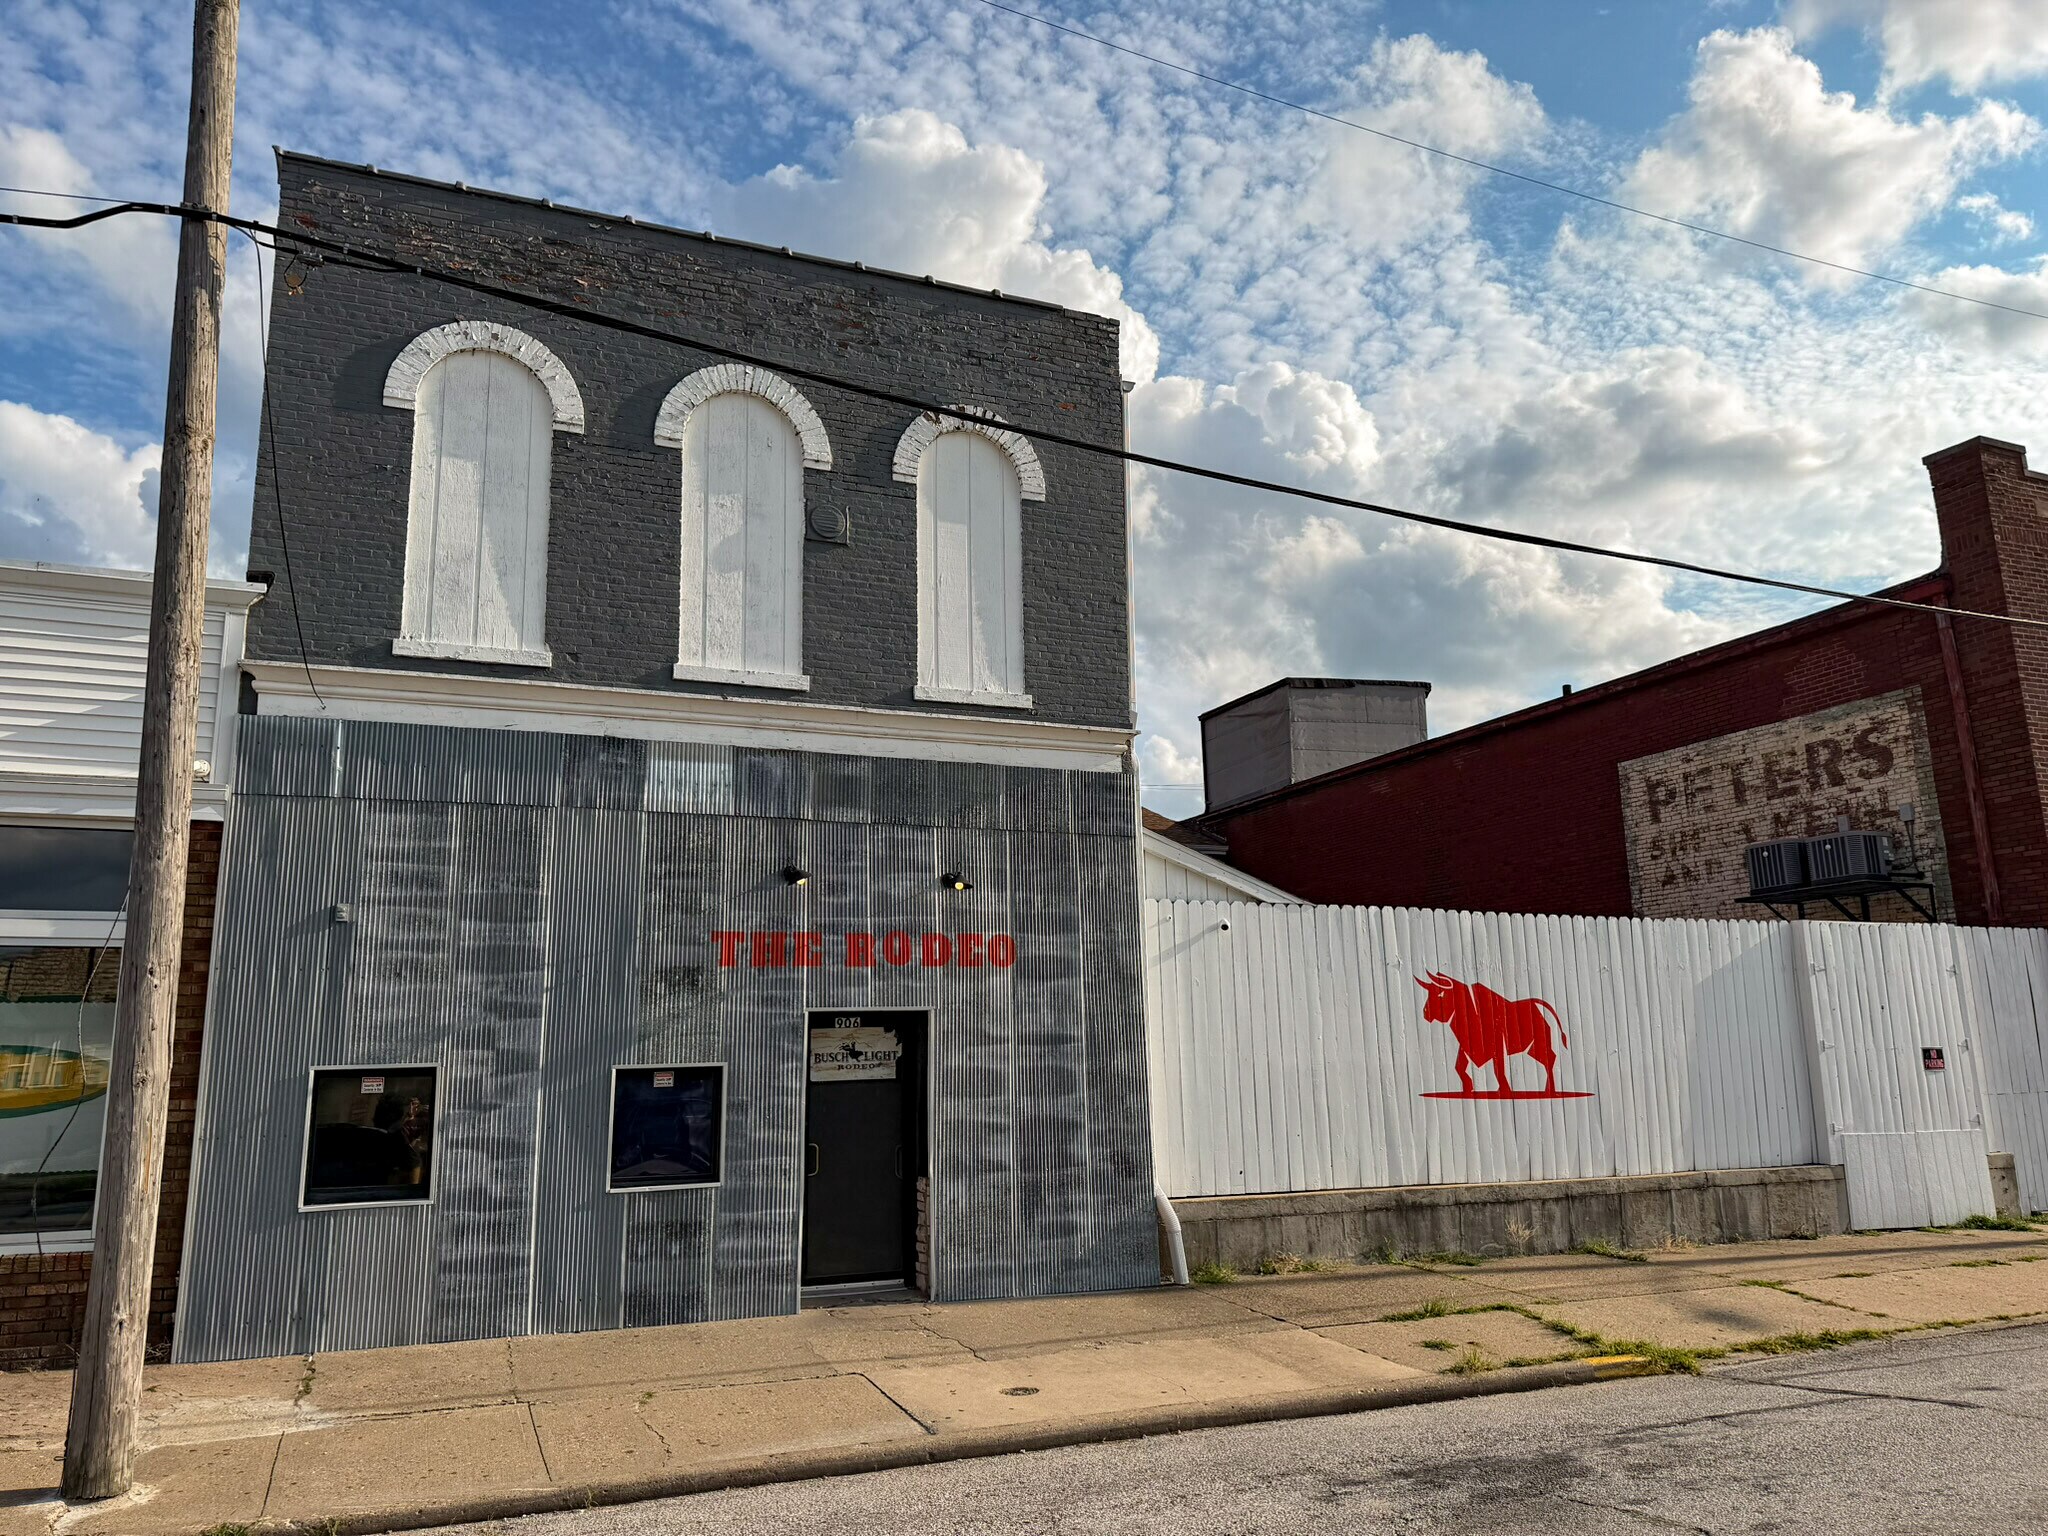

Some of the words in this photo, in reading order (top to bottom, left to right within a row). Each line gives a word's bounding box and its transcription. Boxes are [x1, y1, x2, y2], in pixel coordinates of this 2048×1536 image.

[1646, 724, 1896, 823] PETERS
[711, 930, 822, 968] THE
[845, 930, 1017, 968] RODEO
[836, 1018, 859, 1028] 906
[814, 1051, 849, 1064] BUSCH
[864, 1050, 898, 1062] LIGHT
